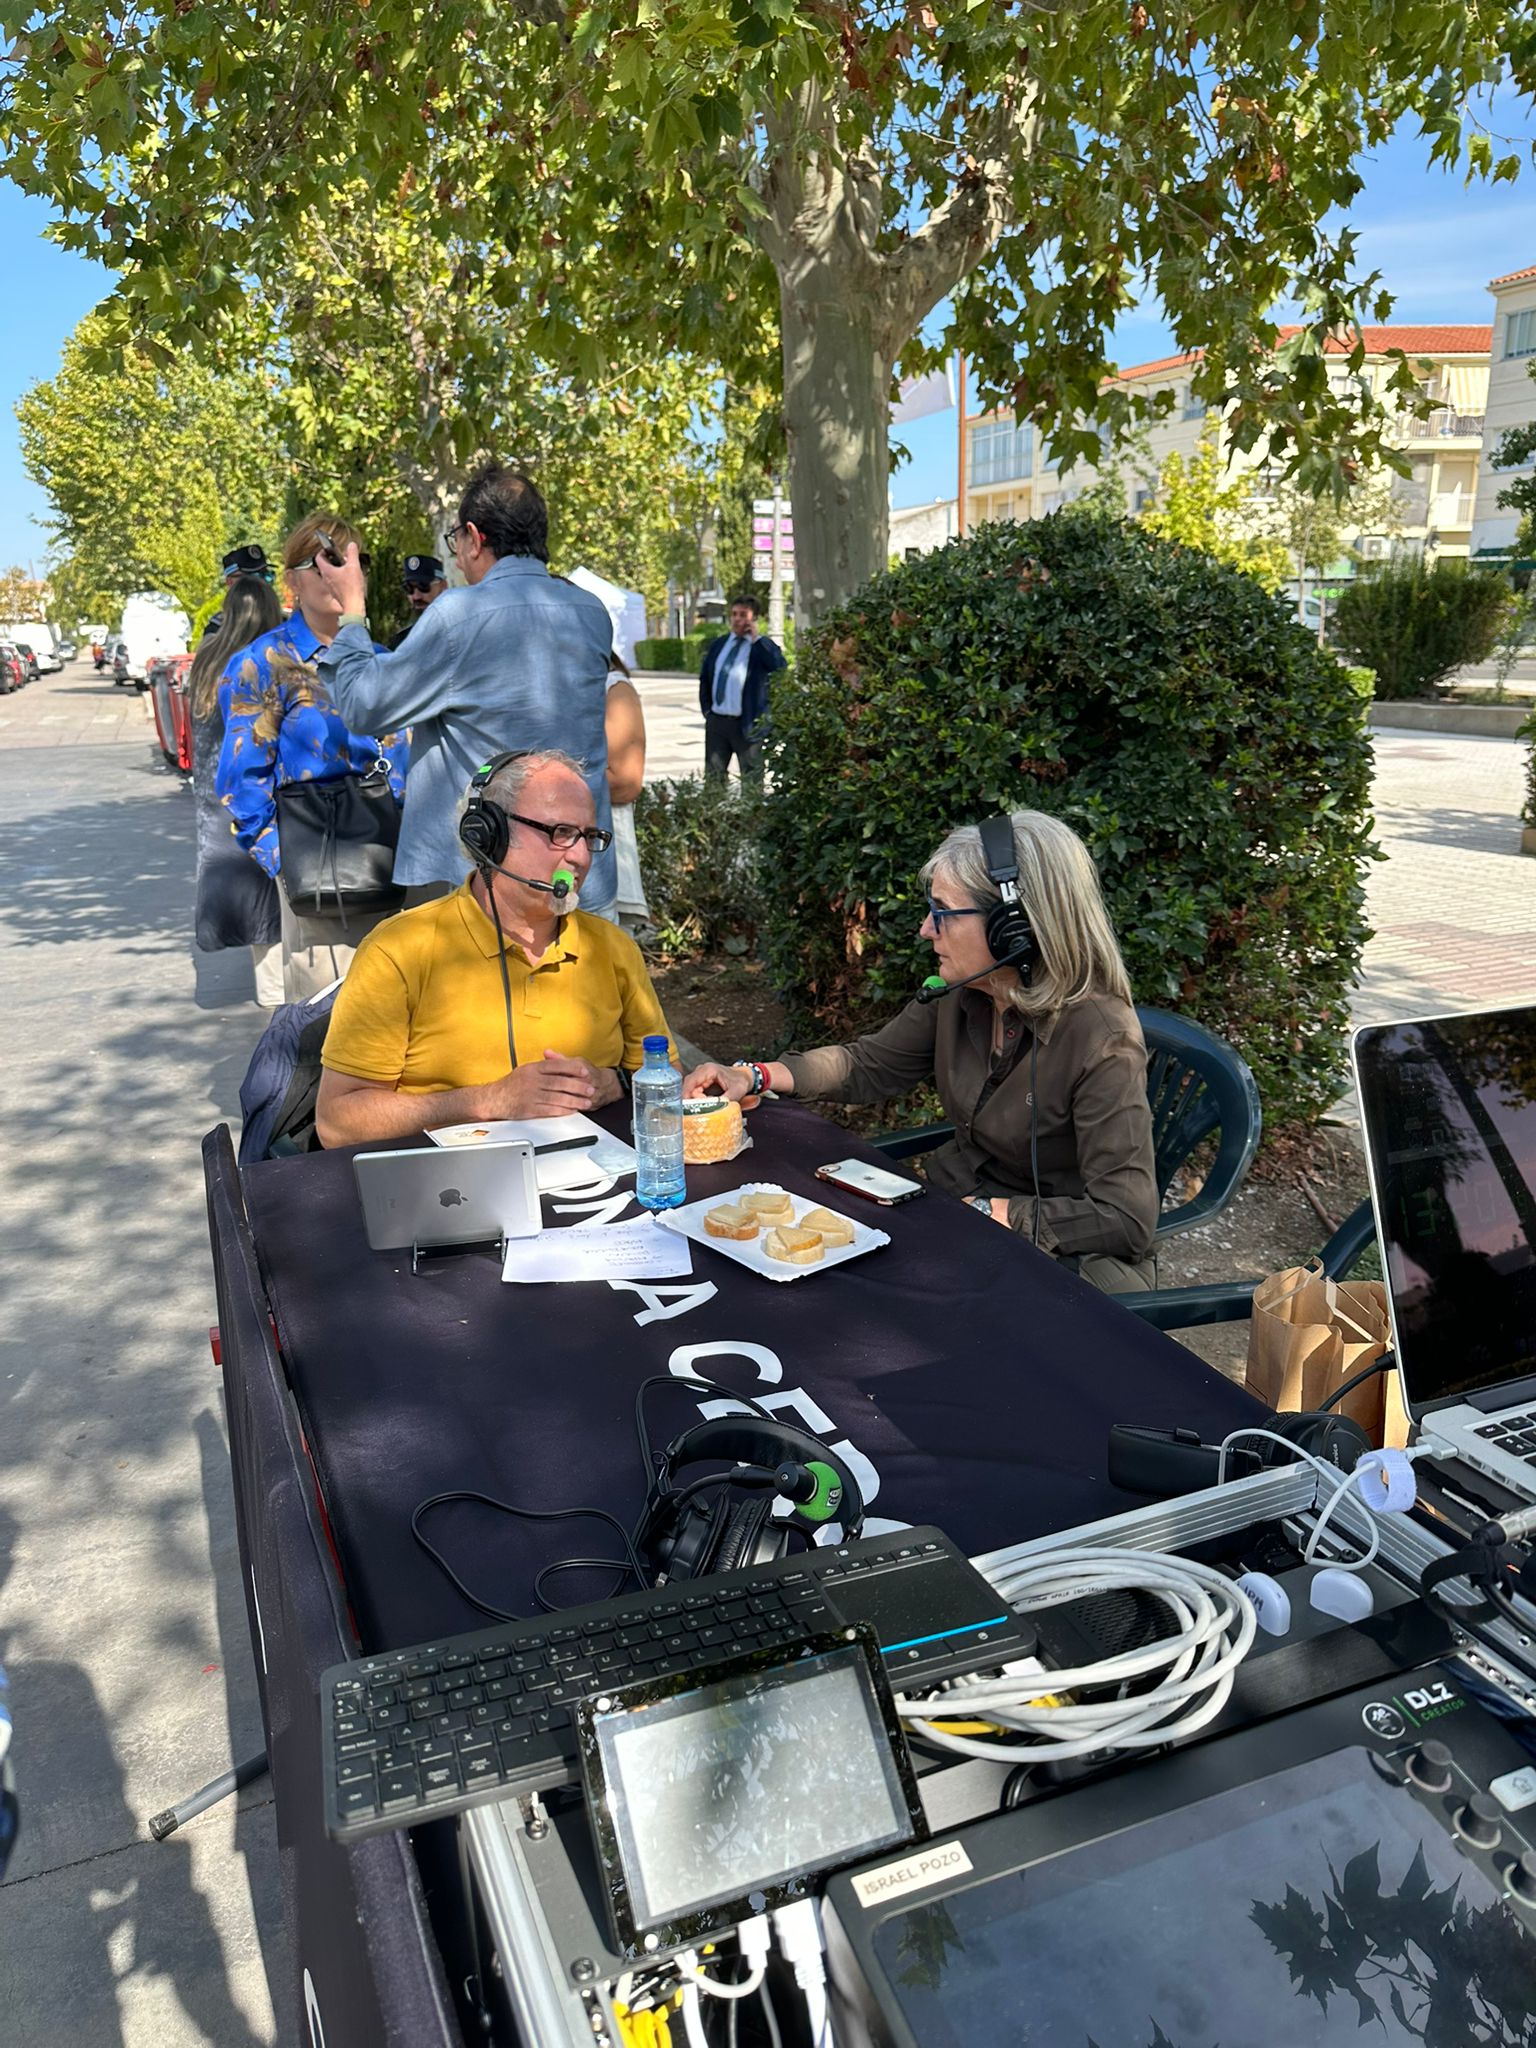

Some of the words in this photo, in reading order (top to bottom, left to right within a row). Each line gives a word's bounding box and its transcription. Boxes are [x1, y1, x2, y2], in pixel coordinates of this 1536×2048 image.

[1403, 1681, 1457, 1710] DLZ
[1420, 1699, 1467, 1721] CREATOR
[863, 1868, 919, 1895] ISRAEL
[920, 1851, 961, 1875] POZO
